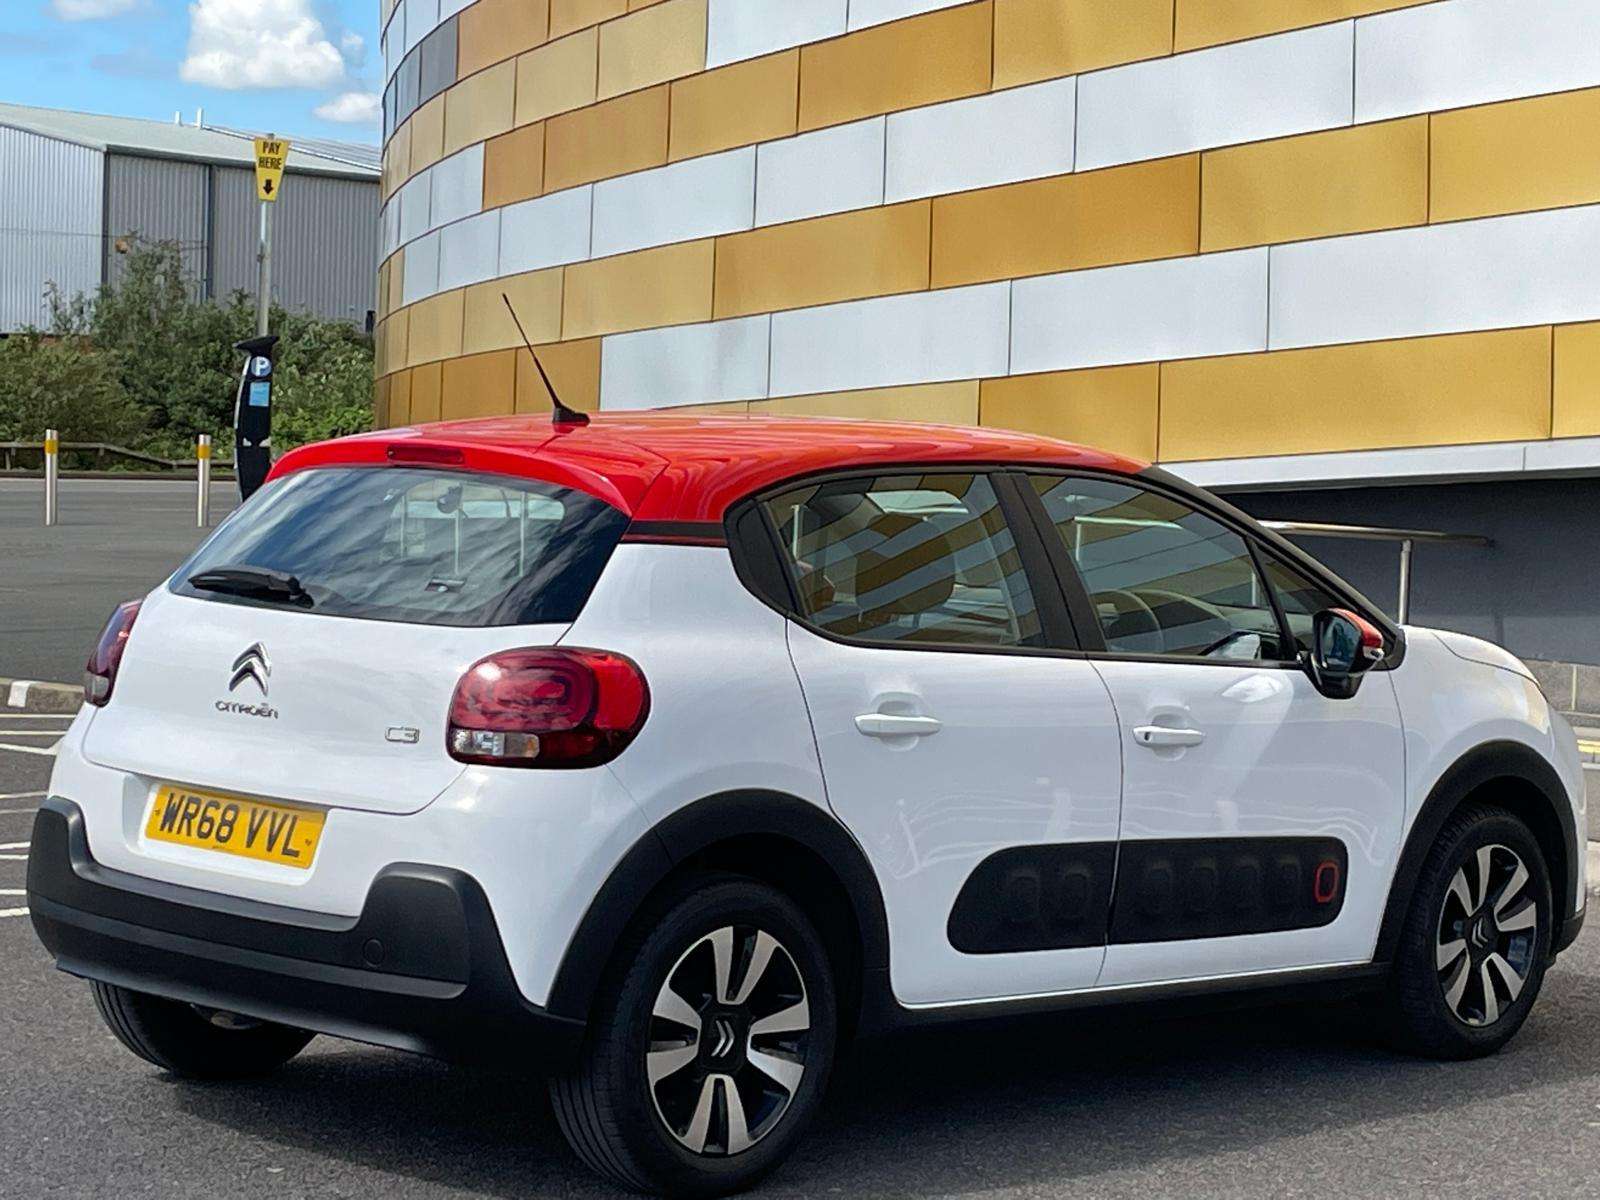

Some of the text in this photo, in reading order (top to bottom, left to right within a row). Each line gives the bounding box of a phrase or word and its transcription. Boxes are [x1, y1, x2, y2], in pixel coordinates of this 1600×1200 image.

[262, 141, 282, 155] PAY
[258, 156, 282, 170] HERE
[255, 356, 269, 376] P
[384, 726, 420, 744] C3
[159, 792, 301, 858] WR68 VVL
